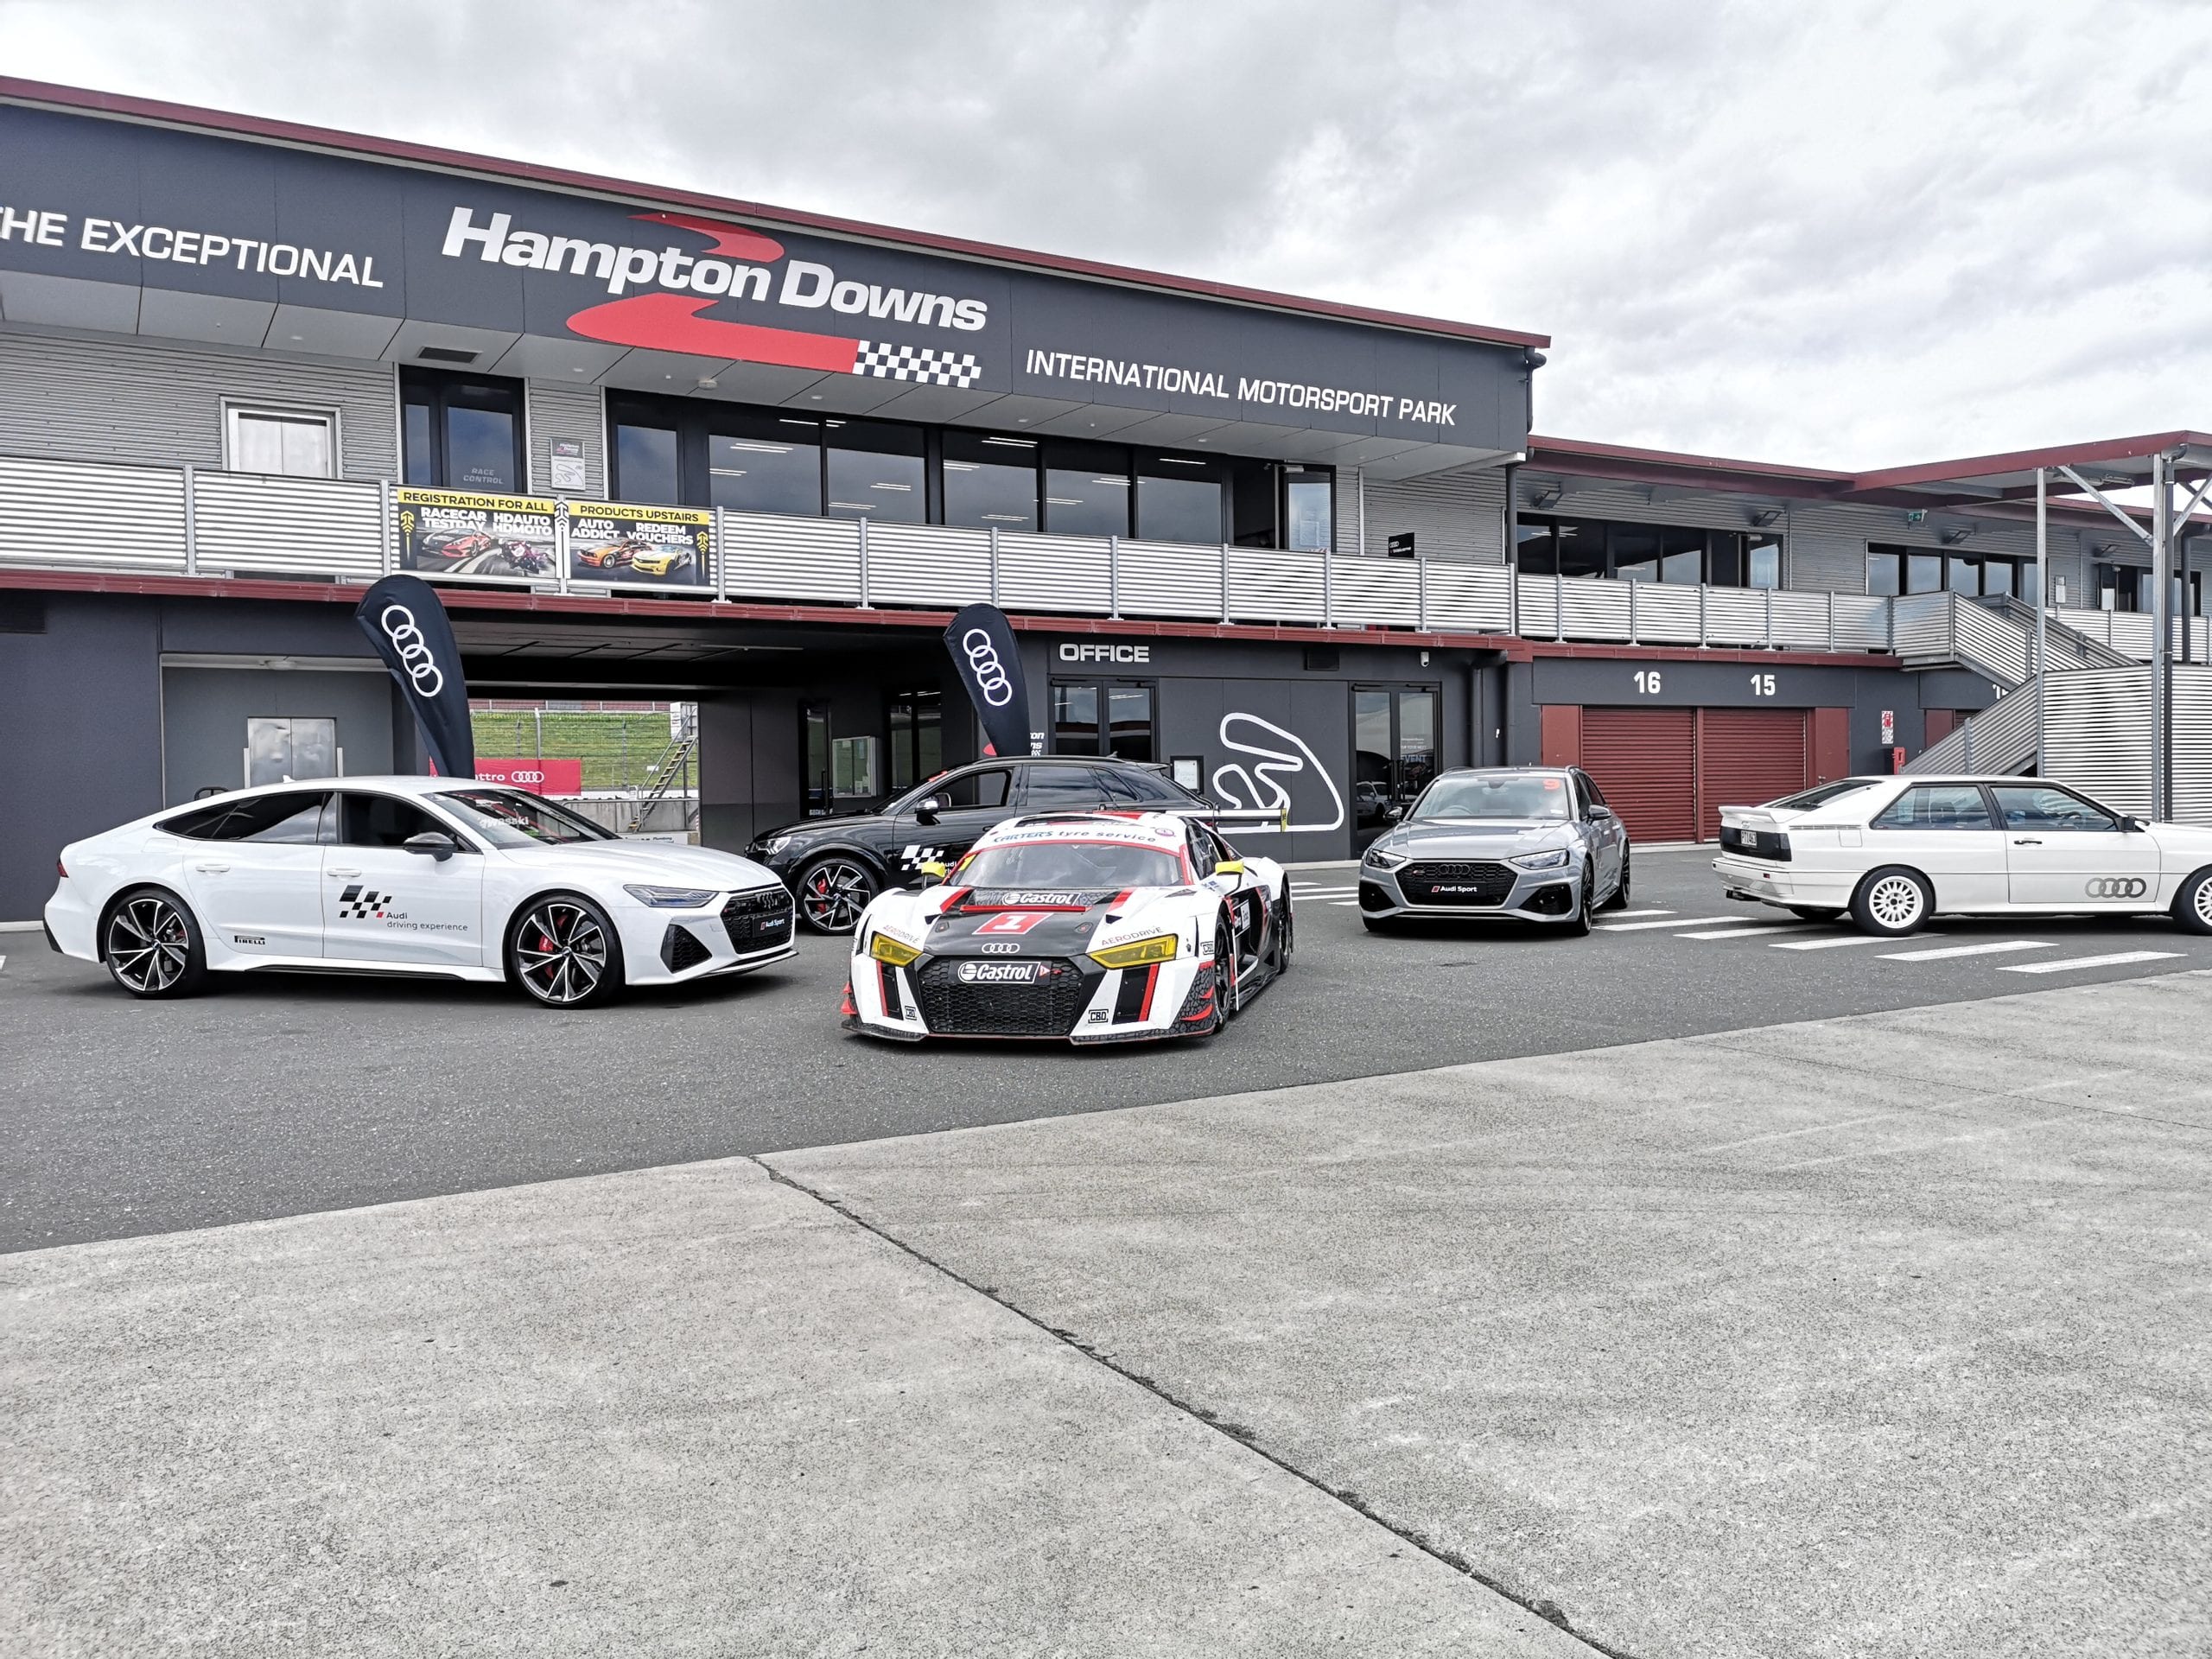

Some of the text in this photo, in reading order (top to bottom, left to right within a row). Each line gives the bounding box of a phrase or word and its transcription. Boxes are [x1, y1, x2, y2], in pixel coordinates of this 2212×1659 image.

[0, 206, 384, 289] HE EXCEPTIONAL
[442, 206, 988, 332] Hampton Downs
[1025, 348, 1458, 427] INTERNATIONAL MOTORSPORT PARK
[472, 467, 495, 476] RACE
[463, 475, 504, 485] CONTROL
[404, 492, 548, 512] REGISTRATION FOR ALL
[421, 506, 487, 522] RACECAR
[493, 512, 551, 526] HDAUTO
[580, 505, 699, 522] PRODUCTS UPSTAIRS
[423, 518, 486, 531] TESTDAY
[493, 523, 553, 536] HDMOTO
[577, 518, 614, 530] AUTO
[635, 522, 686, 535] REDEEM
[571, 528, 620, 540] ADDICT
[626, 531, 694, 545] VOUCHERS
[1059, 644, 1150, 663] OFFICE
[1633, 671, 1662, 694] 16
[1750, 674, 1776, 696] 15
[477, 816, 529, 829] awasaki
[1097, 831, 1156, 842] service
[1020, 893, 1073, 905] Castrol
[386, 912, 408, 920] Audi
[993, 915, 1027, 930] 1
[386, 920, 468, 932] driving experience
[234, 935, 266, 945] PIRELLI
[883, 925, 920, 944] AERODRIVE
[1101, 926, 1164, 946] AERODRIVE
[976, 962, 1033, 981] Castrol
[1090, 1011, 1107, 1022] CBD
